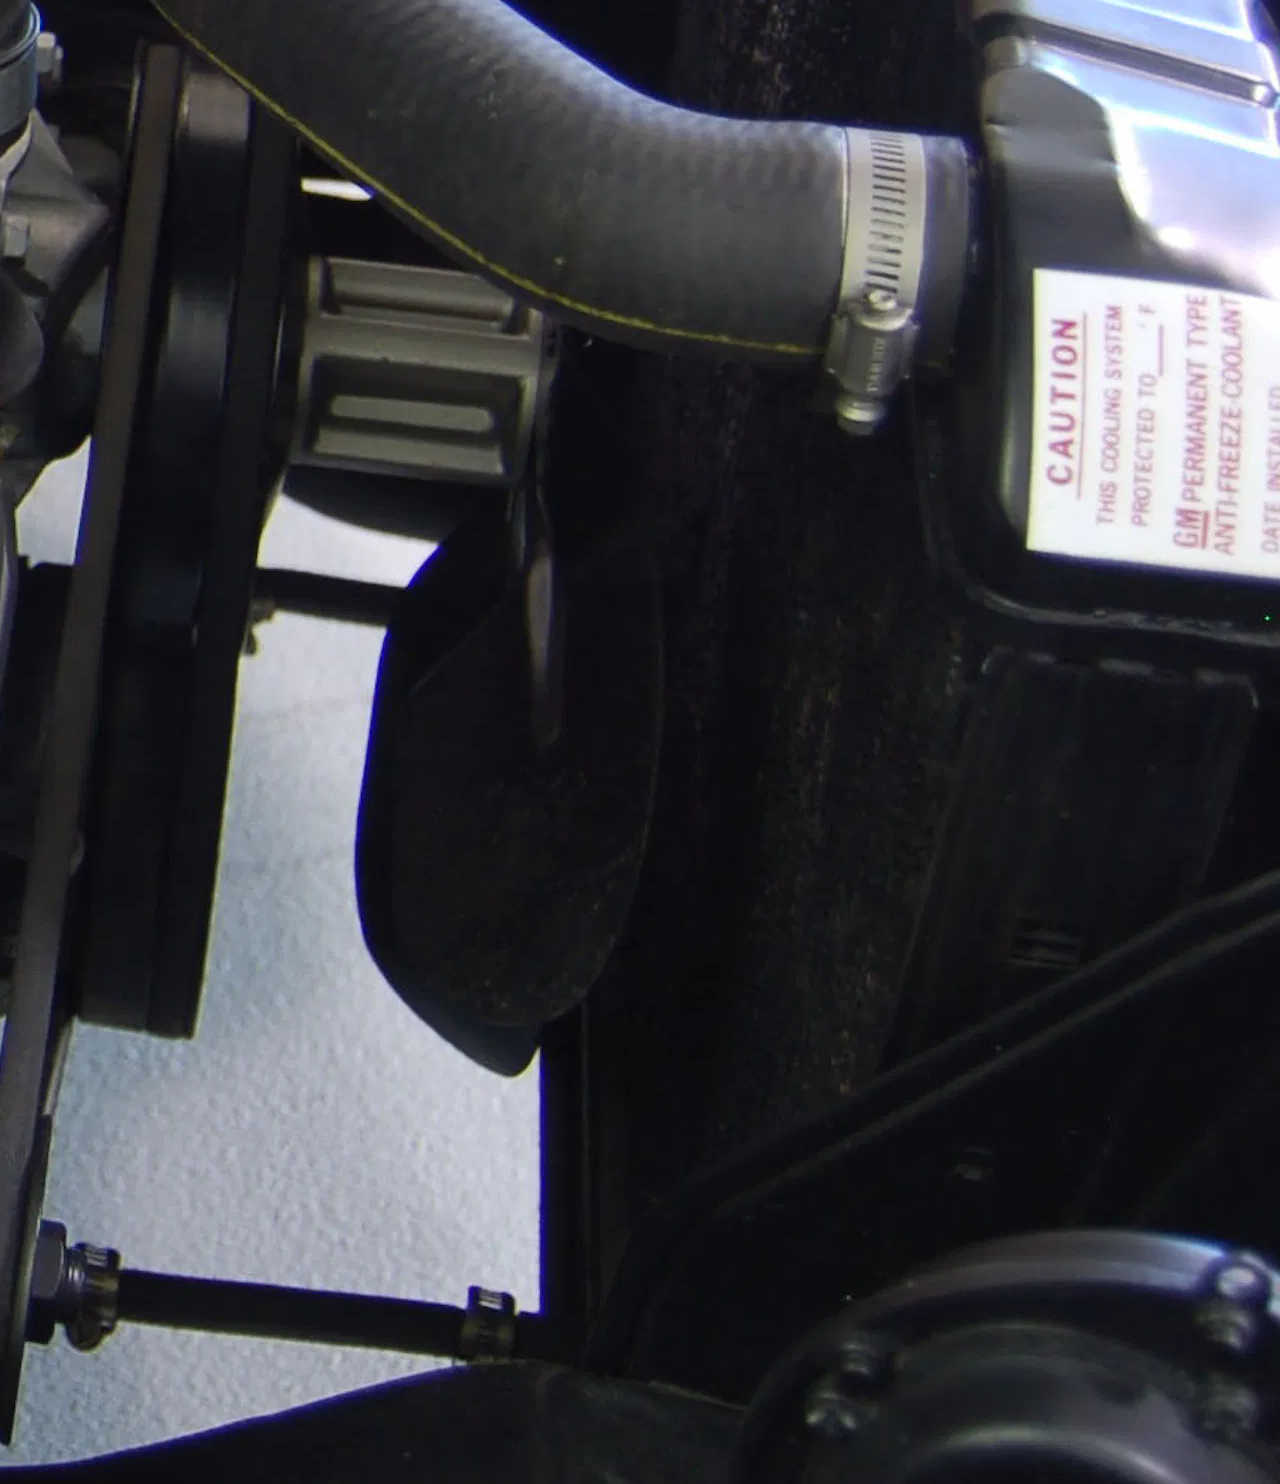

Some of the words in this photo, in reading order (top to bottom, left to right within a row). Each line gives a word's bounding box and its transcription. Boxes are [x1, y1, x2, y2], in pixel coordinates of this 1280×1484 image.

[1104, 304, 1123, 380] SYSTEM
[1185, 293, 1208, 348] TYPE
[1046, 319, 1078, 486] CAUTION
[1138, 373, 1158, 400] TO
[1100, 387, 1122, 474] COOLING
[1130, 408, 1156, 527] PROTECTED
[1181, 359, 1208, 502] PERMANENT
[1096, 480, 1117, 525] THIS
[1172, 506, 1200, 548] GM
